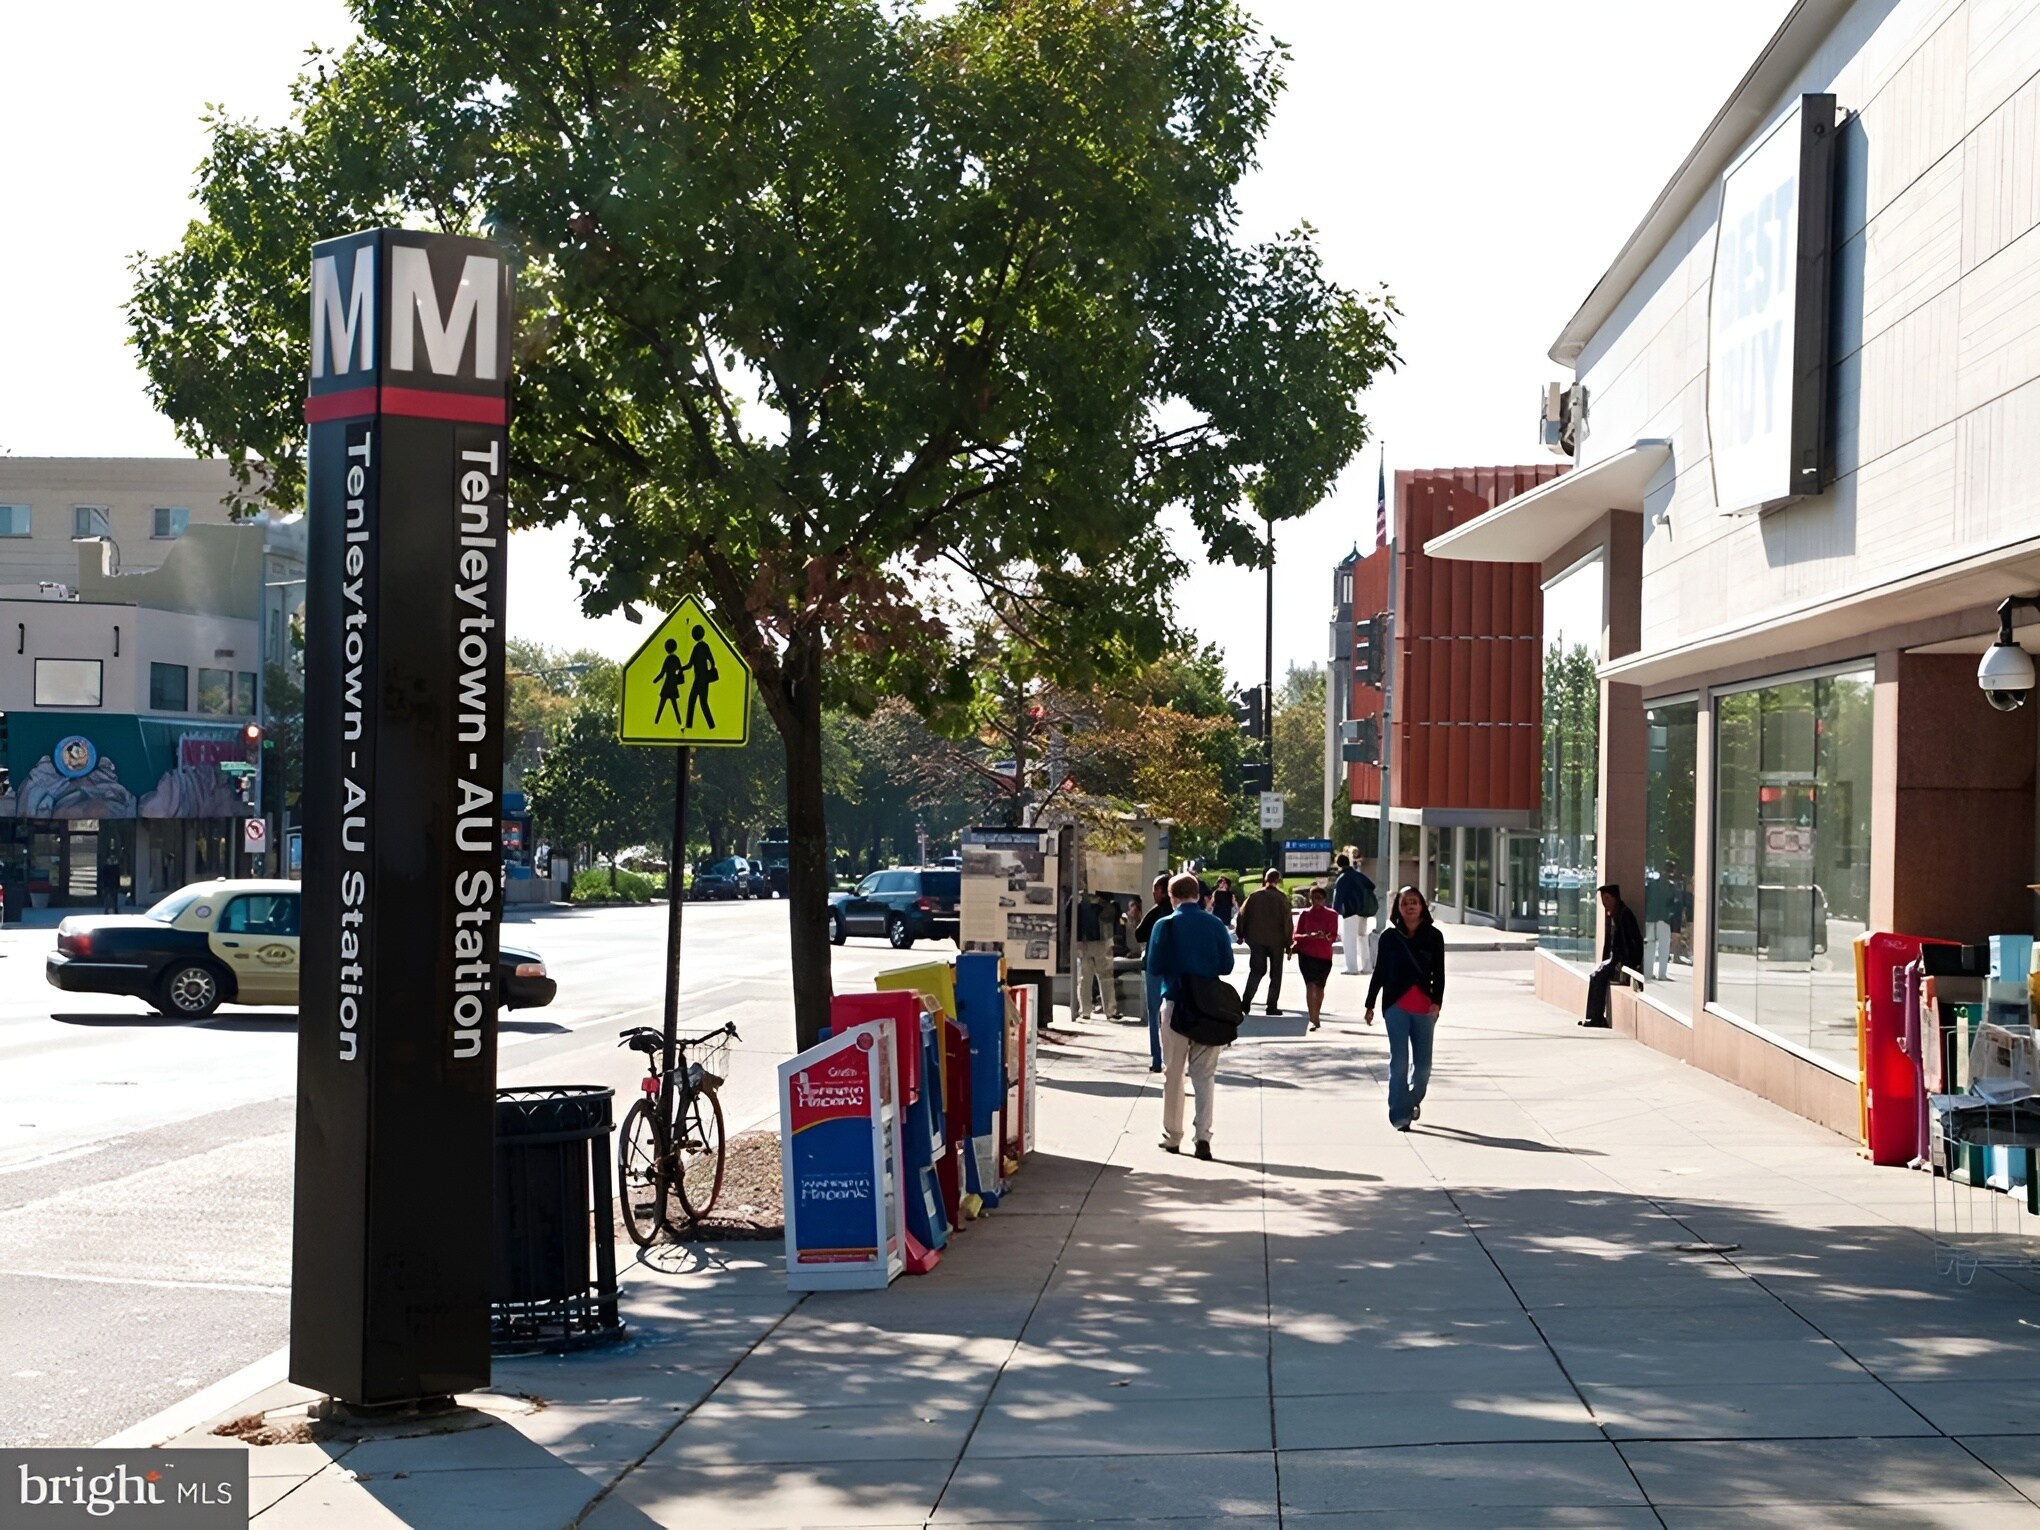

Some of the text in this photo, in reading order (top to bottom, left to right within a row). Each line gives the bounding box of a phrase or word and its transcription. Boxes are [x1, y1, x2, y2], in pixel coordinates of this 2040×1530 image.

[311, 245, 374, 379] M
[390, 244, 499, 380] M
[343, 432, 371, 741] Tenleytown
[454, 440, 499, 742] Tenleytown
[341, 777, 367, 852] AU
[455, 777, 494, 852] AU
[339, 869, 366, 1061] Station
[453, 869, 494, 1059] Station
